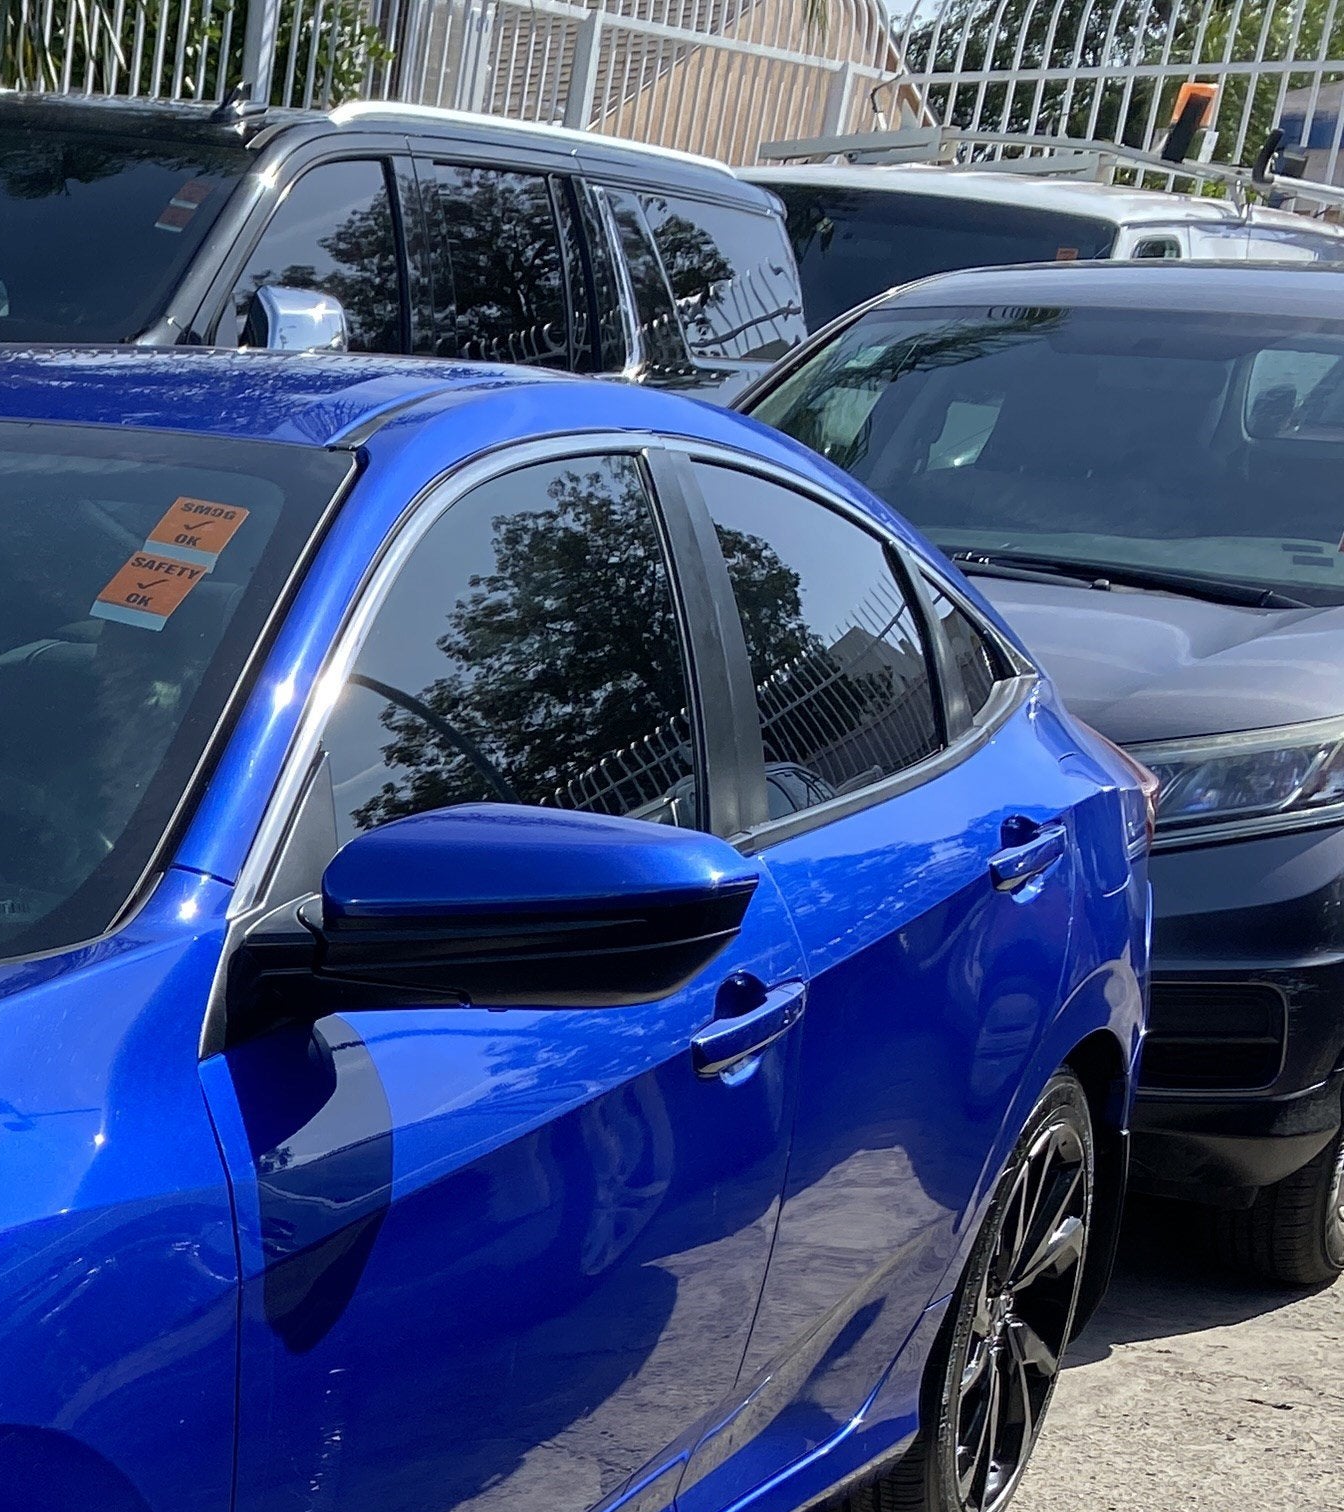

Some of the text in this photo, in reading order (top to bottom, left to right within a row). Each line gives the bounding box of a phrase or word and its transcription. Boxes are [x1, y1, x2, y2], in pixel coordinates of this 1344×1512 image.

[180, 502, 236, 521] SMOG
[174, 533, 202, 547] OK
[131, 557, 200, 580] SAFETY
[125, 592, 154, 607] OK
